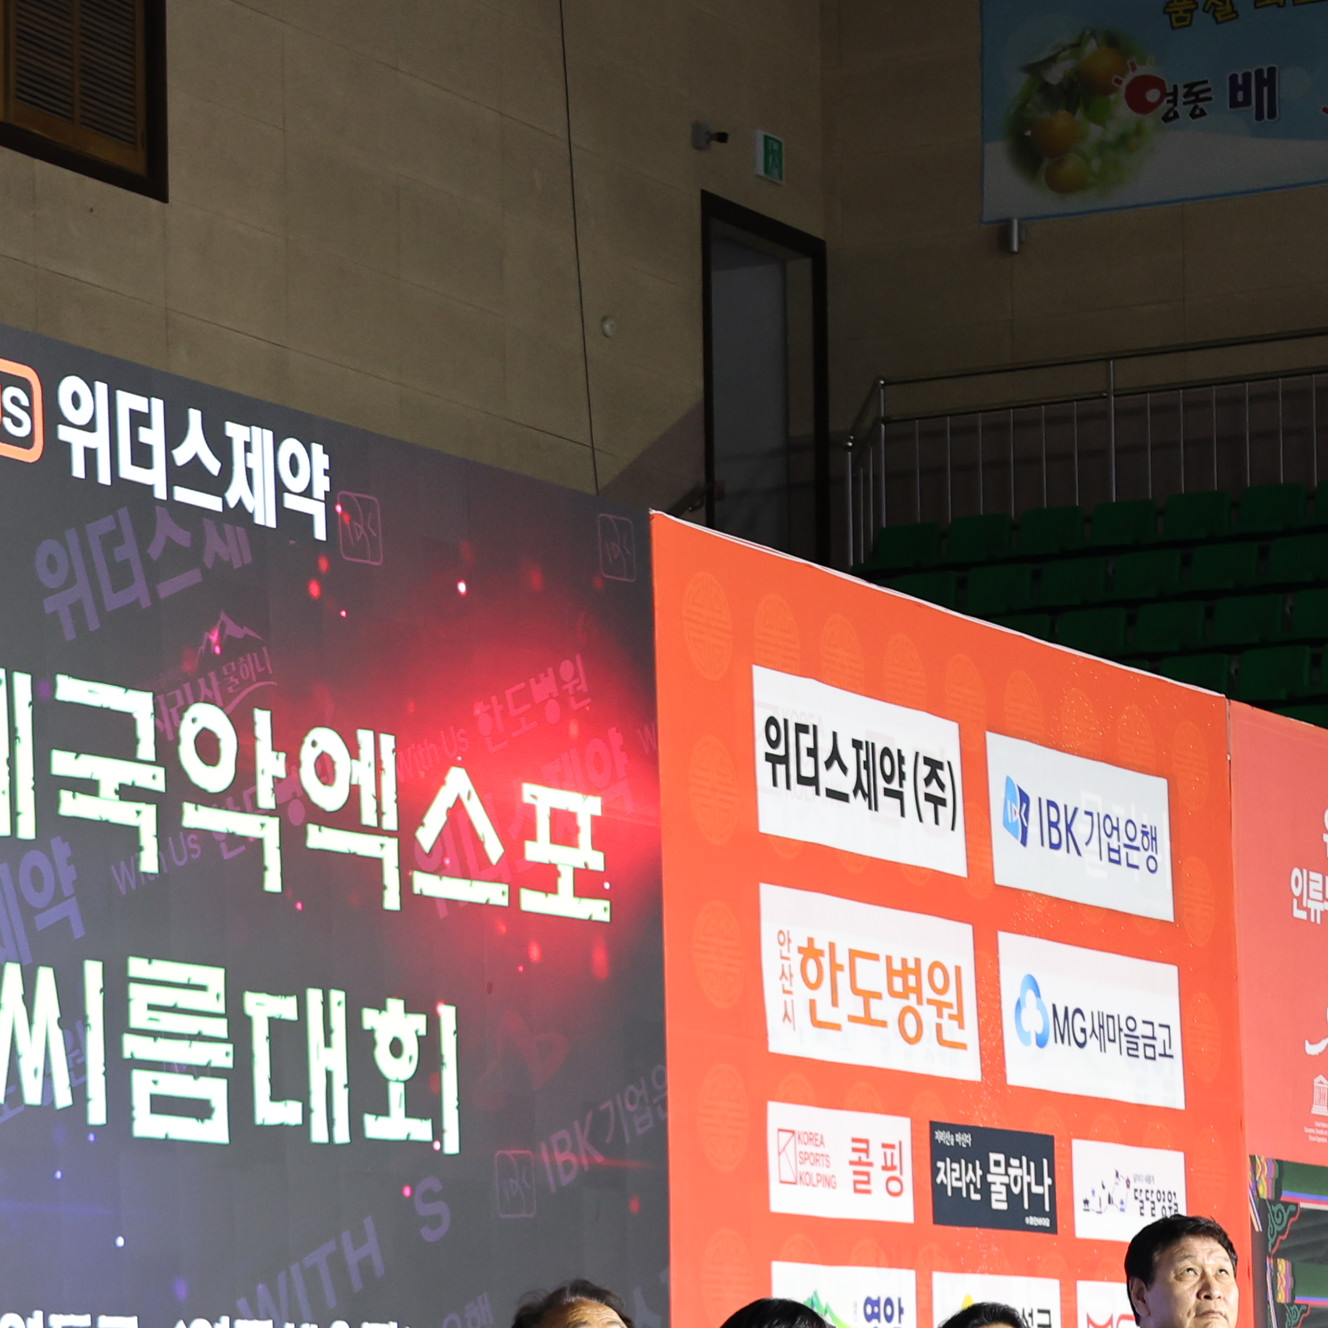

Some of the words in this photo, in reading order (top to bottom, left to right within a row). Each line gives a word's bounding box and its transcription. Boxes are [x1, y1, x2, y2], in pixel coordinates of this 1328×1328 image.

[1227, 66, 1280, 121] 배
[56, 374, 331, 541] 위더스제약
[765, 715, 906, 818] 위더스제약
[913, 751, 957, 832] (주)
[1038, 796, 1159, 874] IBK기업은행
[777, 929, 796, 1032] 안산시
[797, 936, 968, 1051] 한도병원
[1052, 1003, 1174, 1061] MG새마을금고
[797, 1130, 825, 1148] KOREA
[798, 1151, 831, 1169] SPORTS
[799, 1171, 837, 1190] KOLPING
[936, 1157, 983, 1201] 지리산
[986, 1152, 1053, 1212] 물하나
